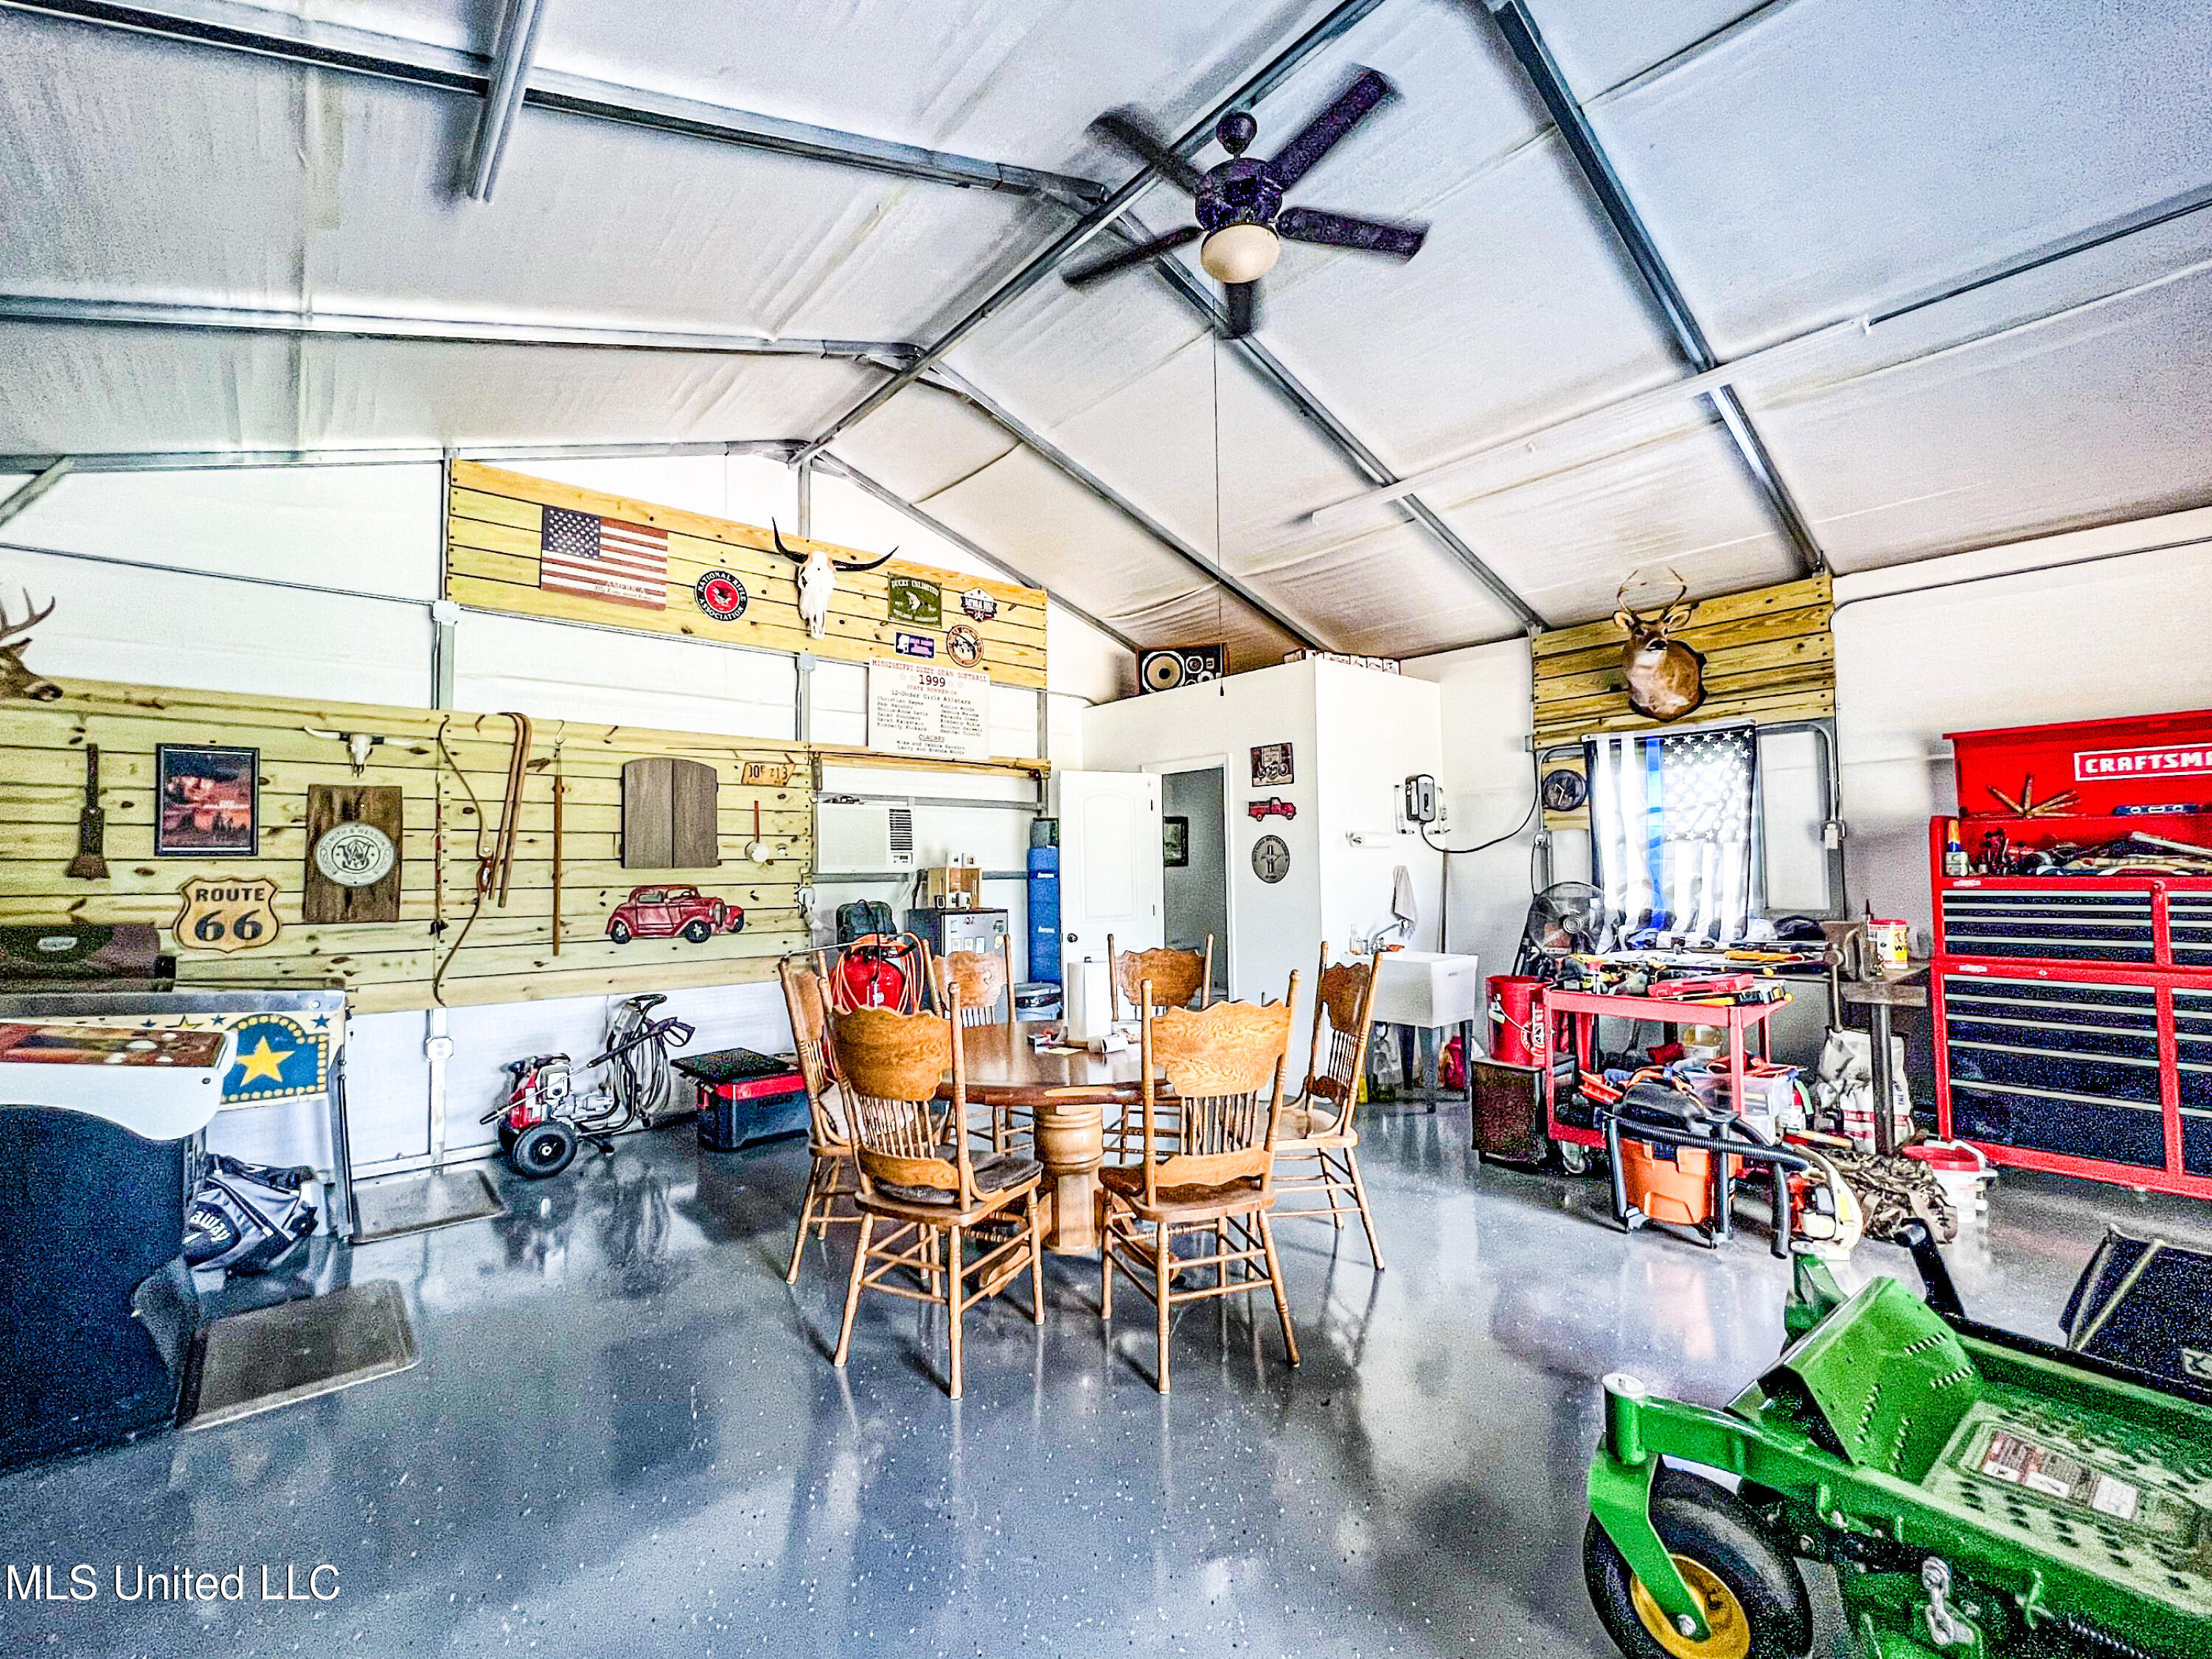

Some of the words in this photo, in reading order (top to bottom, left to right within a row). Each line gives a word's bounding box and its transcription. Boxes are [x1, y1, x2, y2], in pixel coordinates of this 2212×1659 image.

[698, 571, 731, 592] NATIONAL
[732, 580, 746, 601] RIFLE
[698, 599, 744, 620] ASSOCIATION
[872, 660, 914, 671] MISSISSIPPI
[919, 675, 946, 687] 1999
[325, 829, 347, 846] SMITH
[358, 829, 385, 846] WESSON
[195, 888, 265, 902] ROUTE
[195, 908, 262, 941] 66
